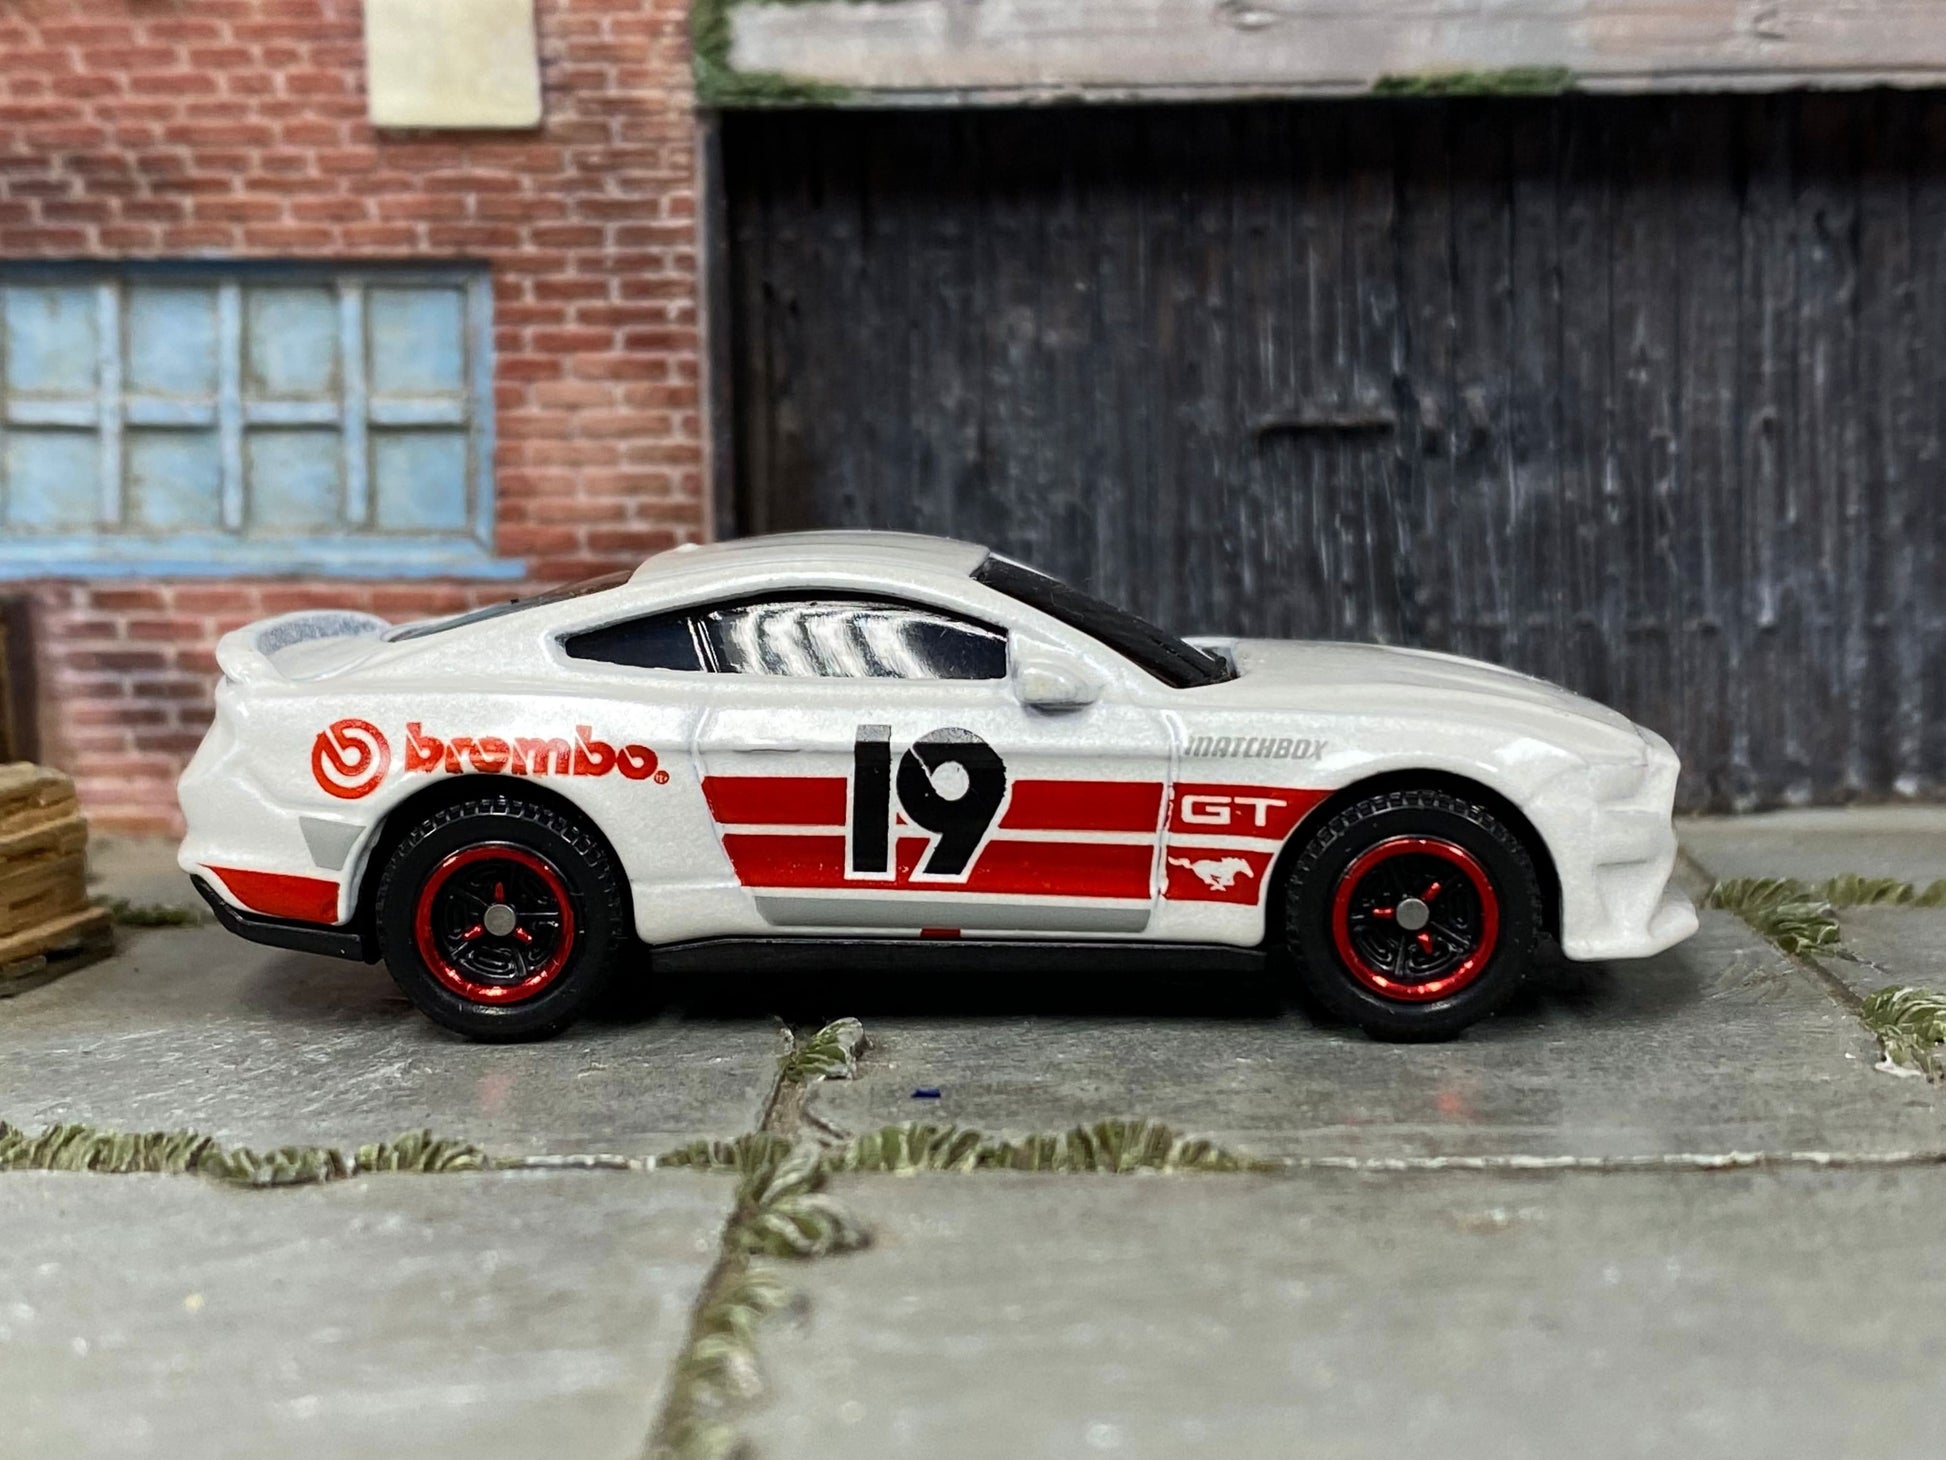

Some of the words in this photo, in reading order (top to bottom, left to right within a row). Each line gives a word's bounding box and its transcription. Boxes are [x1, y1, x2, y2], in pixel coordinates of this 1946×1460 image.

[1184, 735, 1328, 760] MATCHBOX
[851, 724, 1008, 876] 19
[1181, 795, 1287, 827] GT
